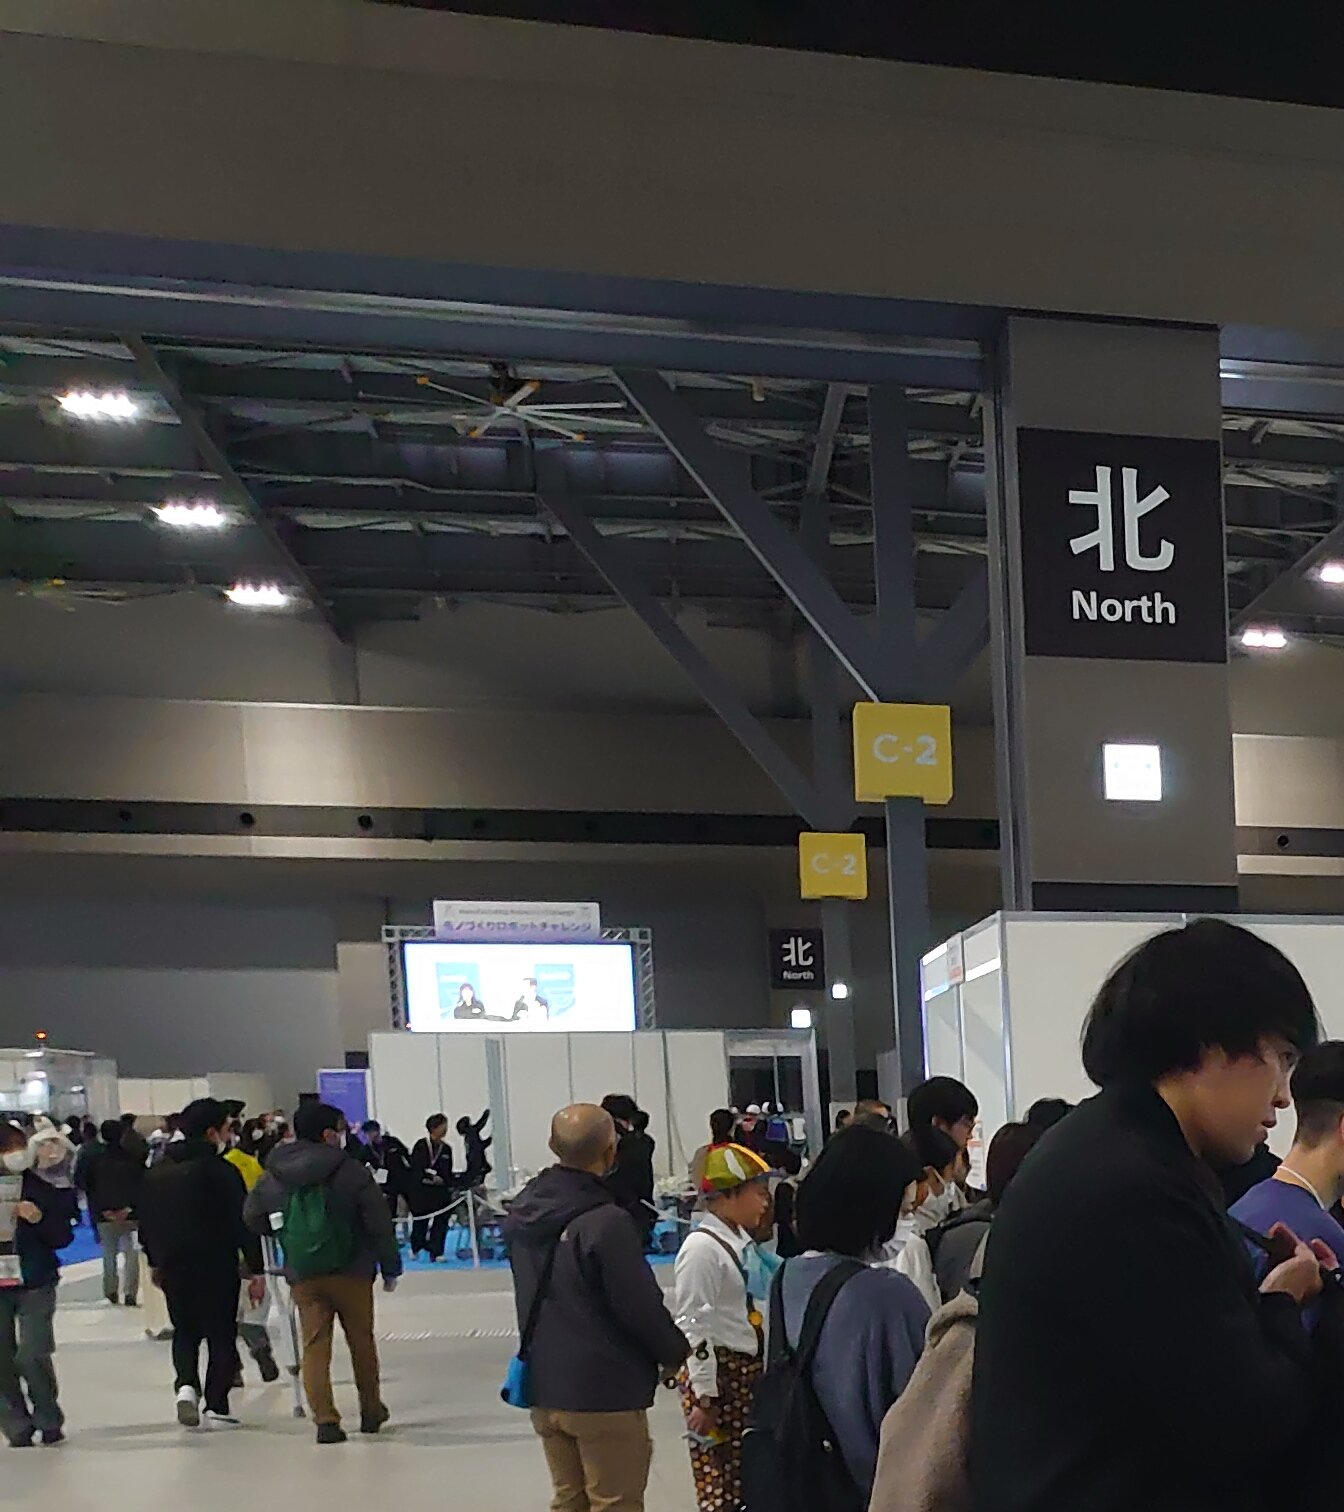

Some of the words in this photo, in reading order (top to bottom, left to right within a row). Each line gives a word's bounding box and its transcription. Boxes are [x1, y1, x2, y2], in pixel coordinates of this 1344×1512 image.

[1068, 465, 1175, 572] 北
[1072, 590, 1176, 624] North
[872, 733, 938, 765] C-2
[782, 936, 814, 966] 北
[783, 970, 815, 980] North
